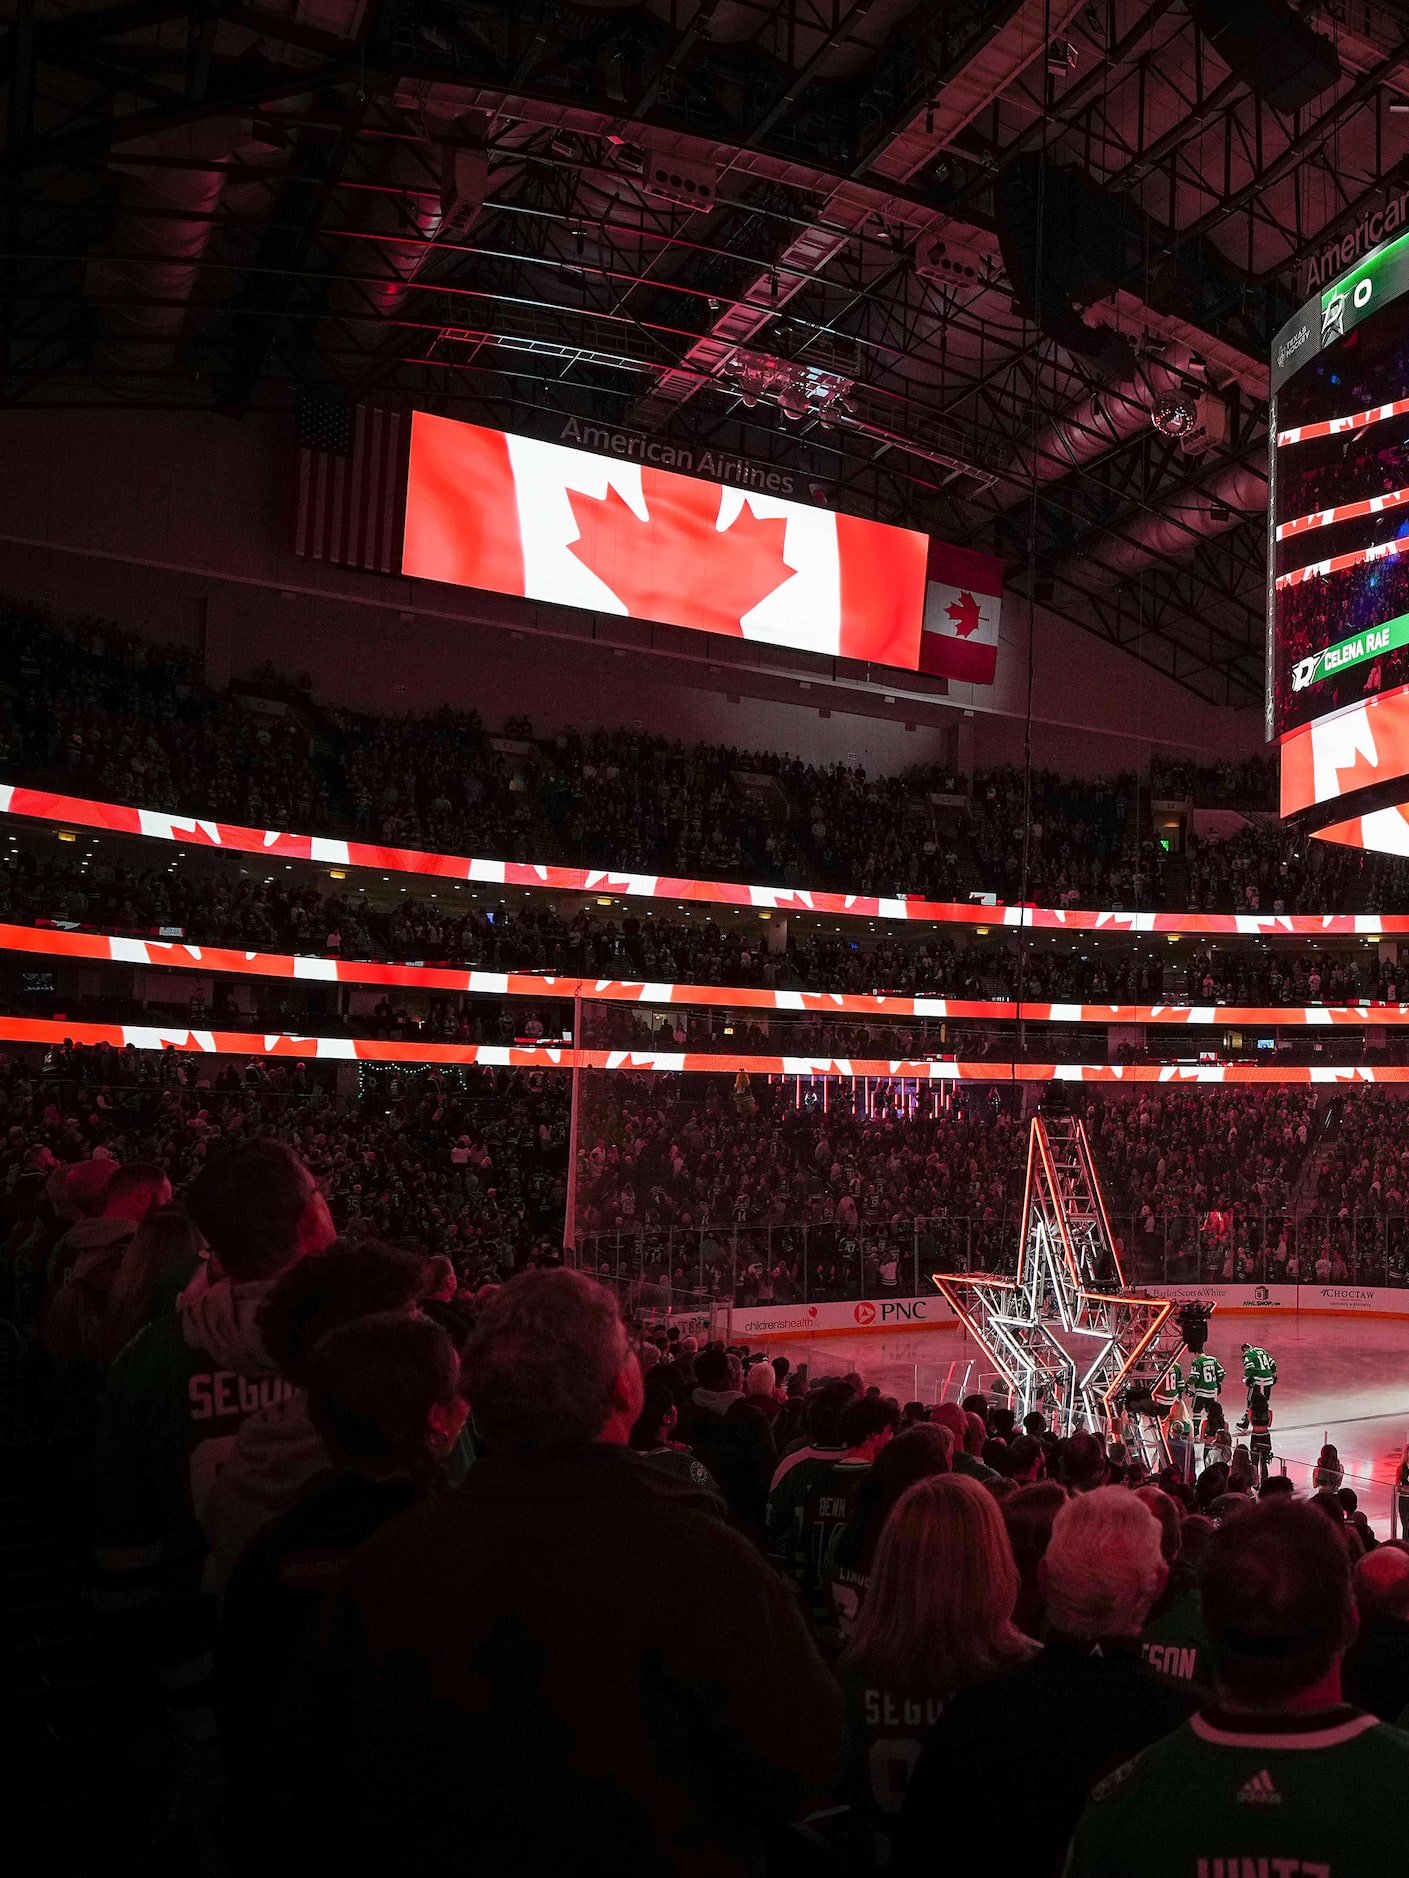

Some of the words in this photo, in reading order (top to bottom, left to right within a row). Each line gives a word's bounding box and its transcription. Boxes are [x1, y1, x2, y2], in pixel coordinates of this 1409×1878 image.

[1354, 278, 1372, 308] 0
[560, 417, 693, 469] American
[697, 452, 794, 494] Airlines
[1324, 639, 1364, 671] CELENA
[1366, 628, 1390, 653] RAE
[1327, 1289, 1375, 1299] CHOCTAW
[881, 1301, 927, 1321] PNC
